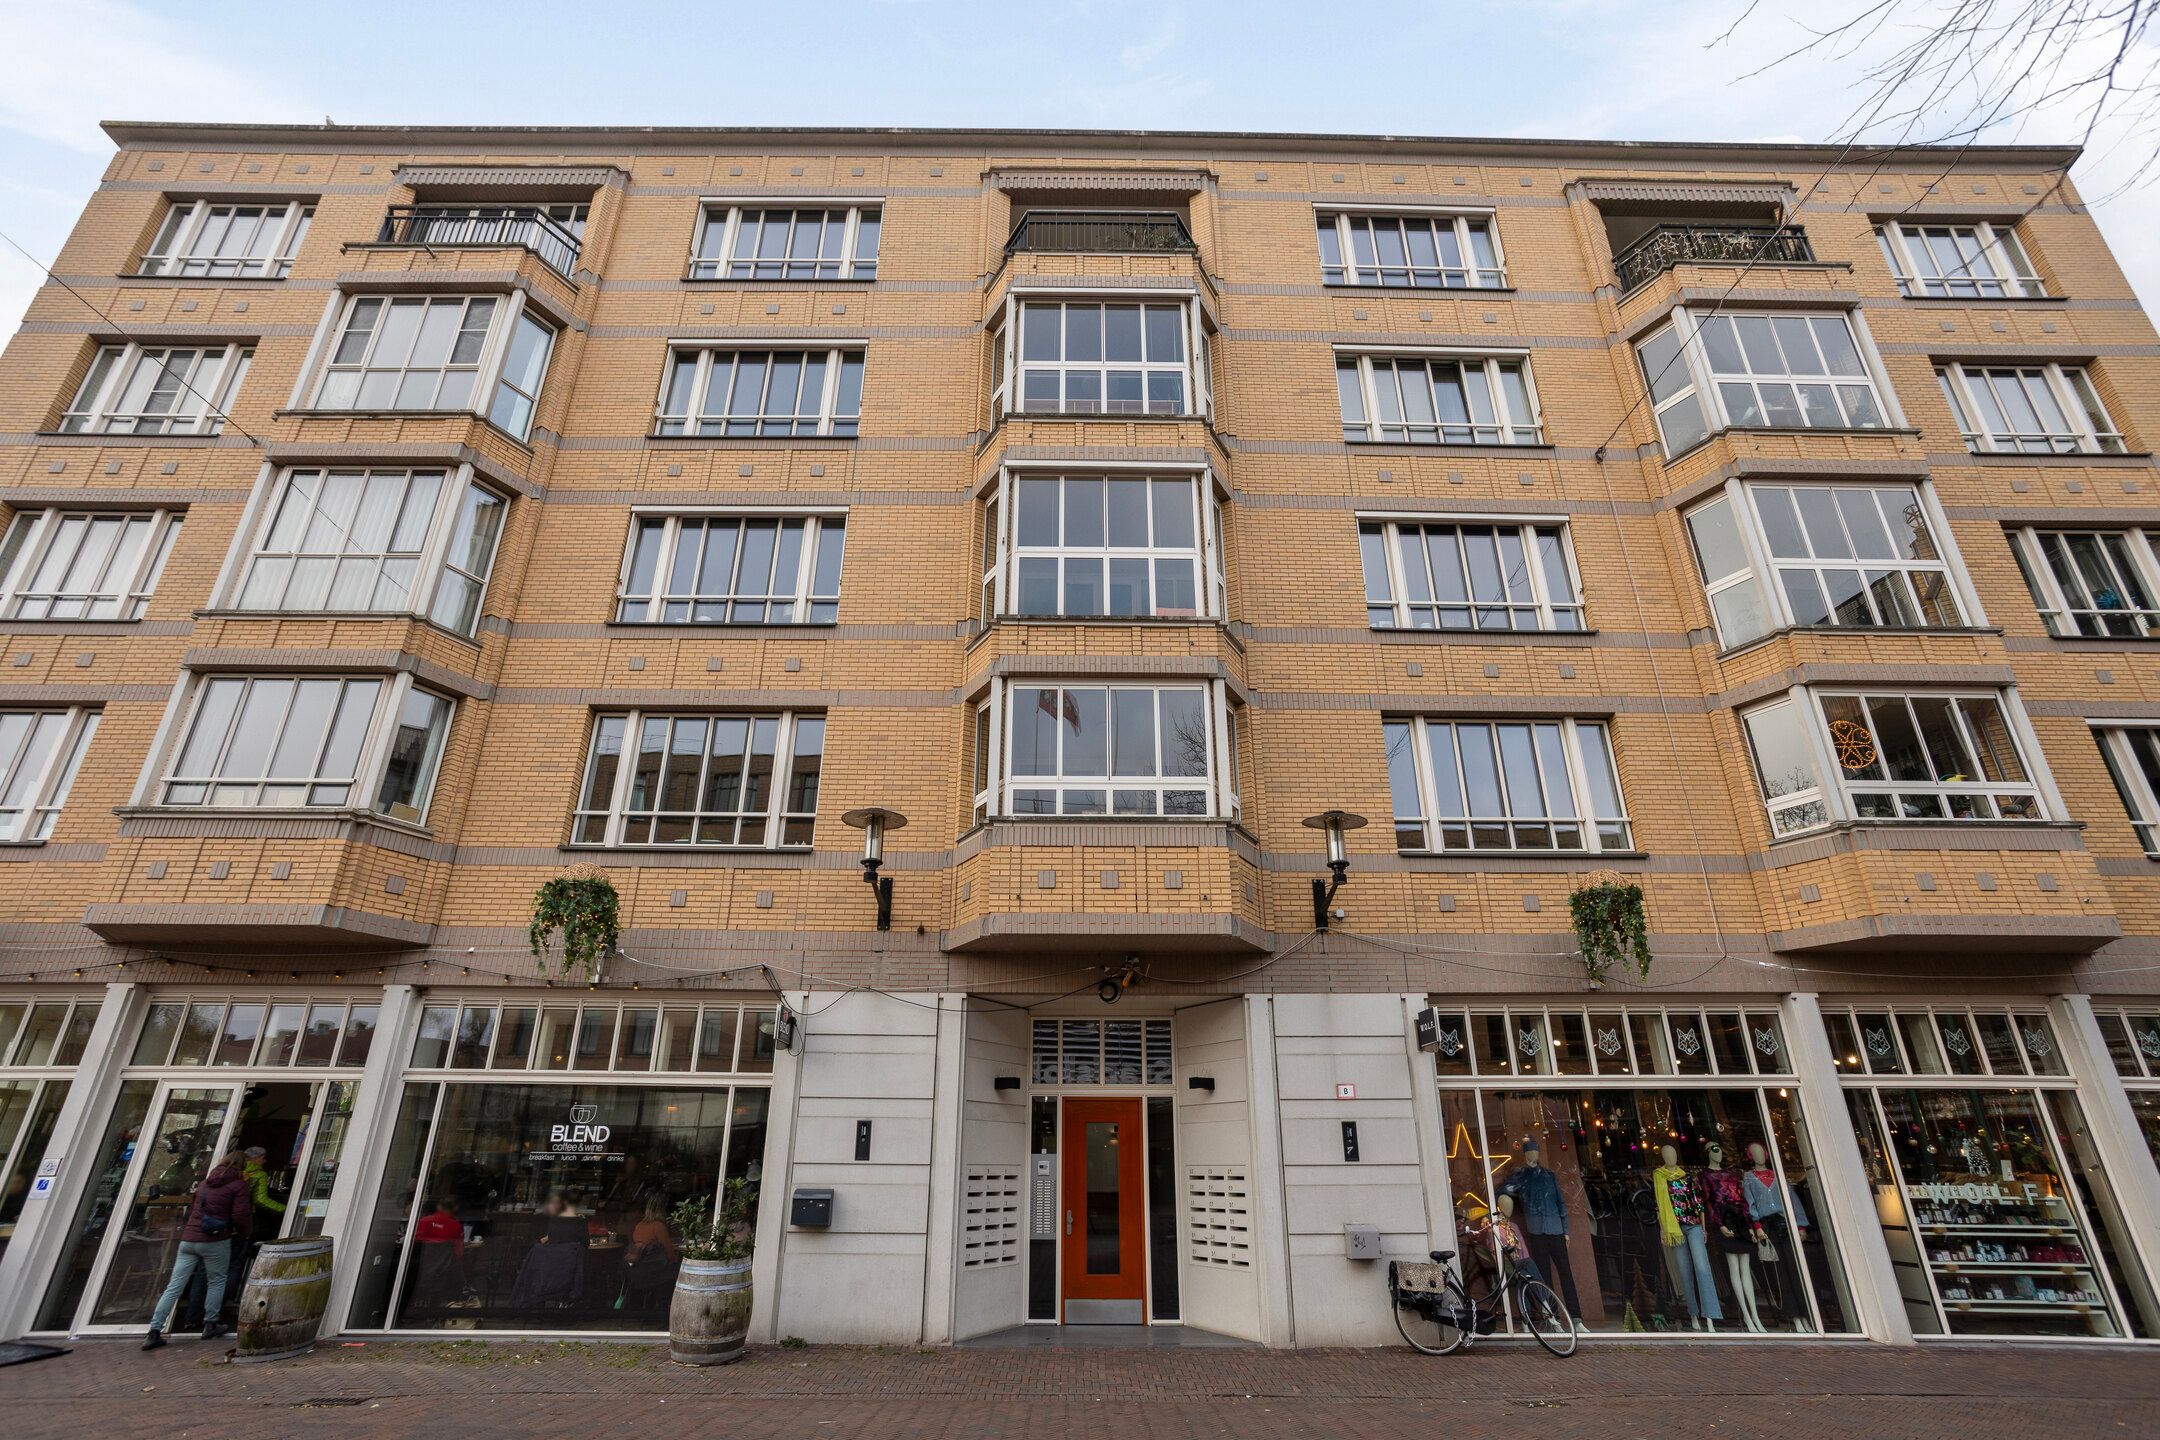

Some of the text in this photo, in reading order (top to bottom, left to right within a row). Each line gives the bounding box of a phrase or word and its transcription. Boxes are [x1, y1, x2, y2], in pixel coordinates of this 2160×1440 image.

[550, 1125, 610, 1142] BLEND
[552, 1142, 603, 1152] coffee & wine
